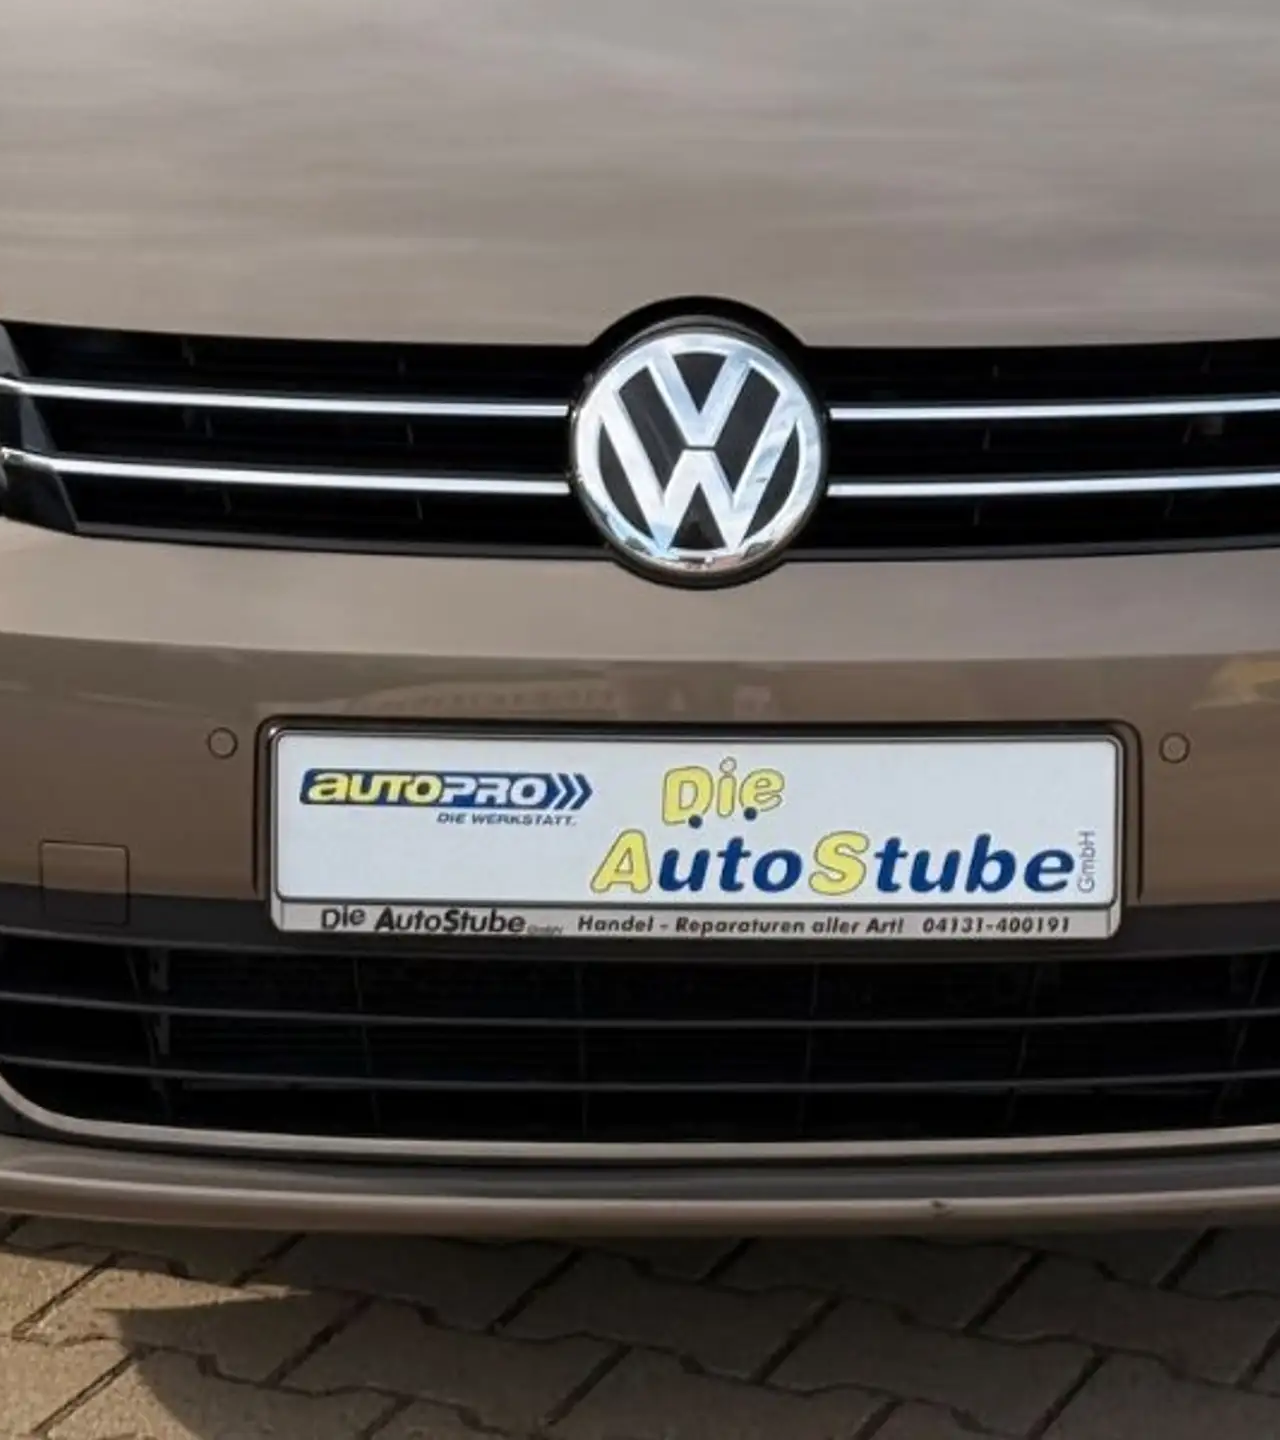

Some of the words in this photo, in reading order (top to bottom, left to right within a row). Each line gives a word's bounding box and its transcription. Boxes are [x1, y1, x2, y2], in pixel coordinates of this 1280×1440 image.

[662, 756, 786, 826] Die
[590, 829, 1074, 896] AutoStube
[1077, 830, 1096, 893] GmbH
[321, 905, 366, 930] Die
[375, 906, 526, 933] AutoStube
[578, 915, 654, 933] Handel
[675, 916, 806, 938] Reparaturen
[812, 916, 860, 934] aller
[922, 915, 1071, 934] 04131-400191
